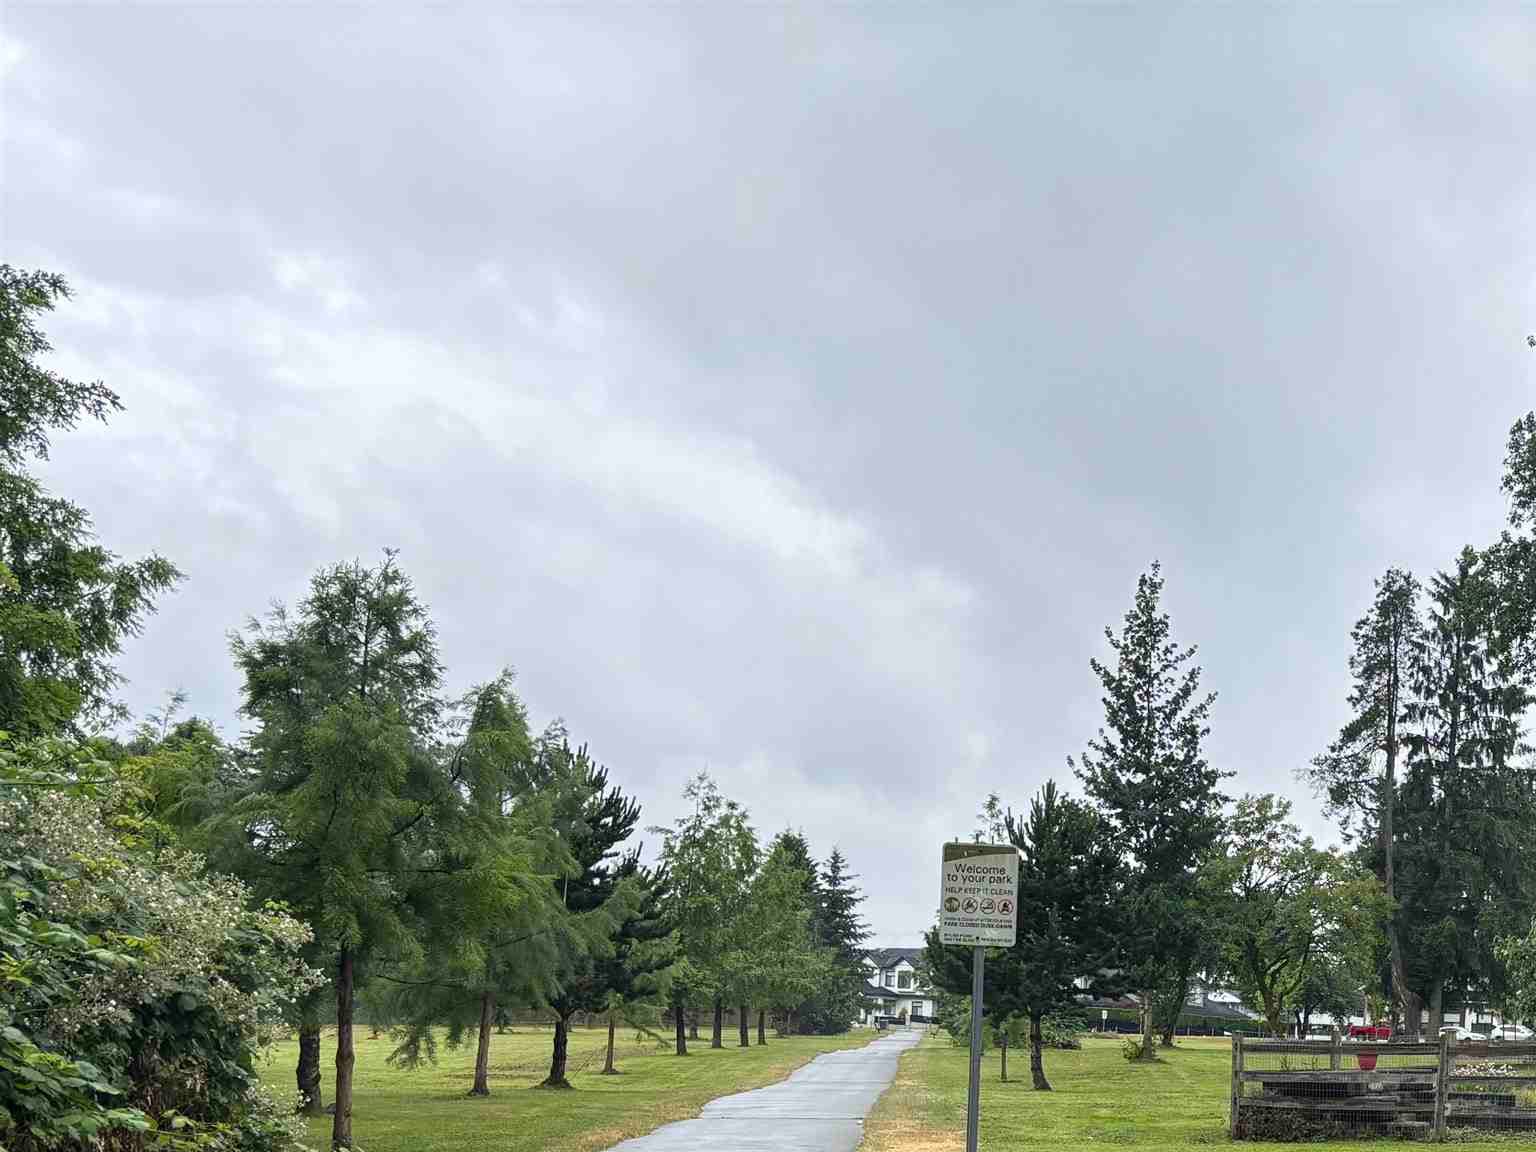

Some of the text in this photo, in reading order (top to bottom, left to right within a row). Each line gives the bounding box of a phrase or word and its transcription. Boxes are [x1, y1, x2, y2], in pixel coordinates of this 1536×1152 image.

[954, 863, 1006, 875] Welcome
[947, 873, 1013, 885] to your park
[964, 887, 981, 895] KEEP
[991, 888, 1013, 896] CLEAN
